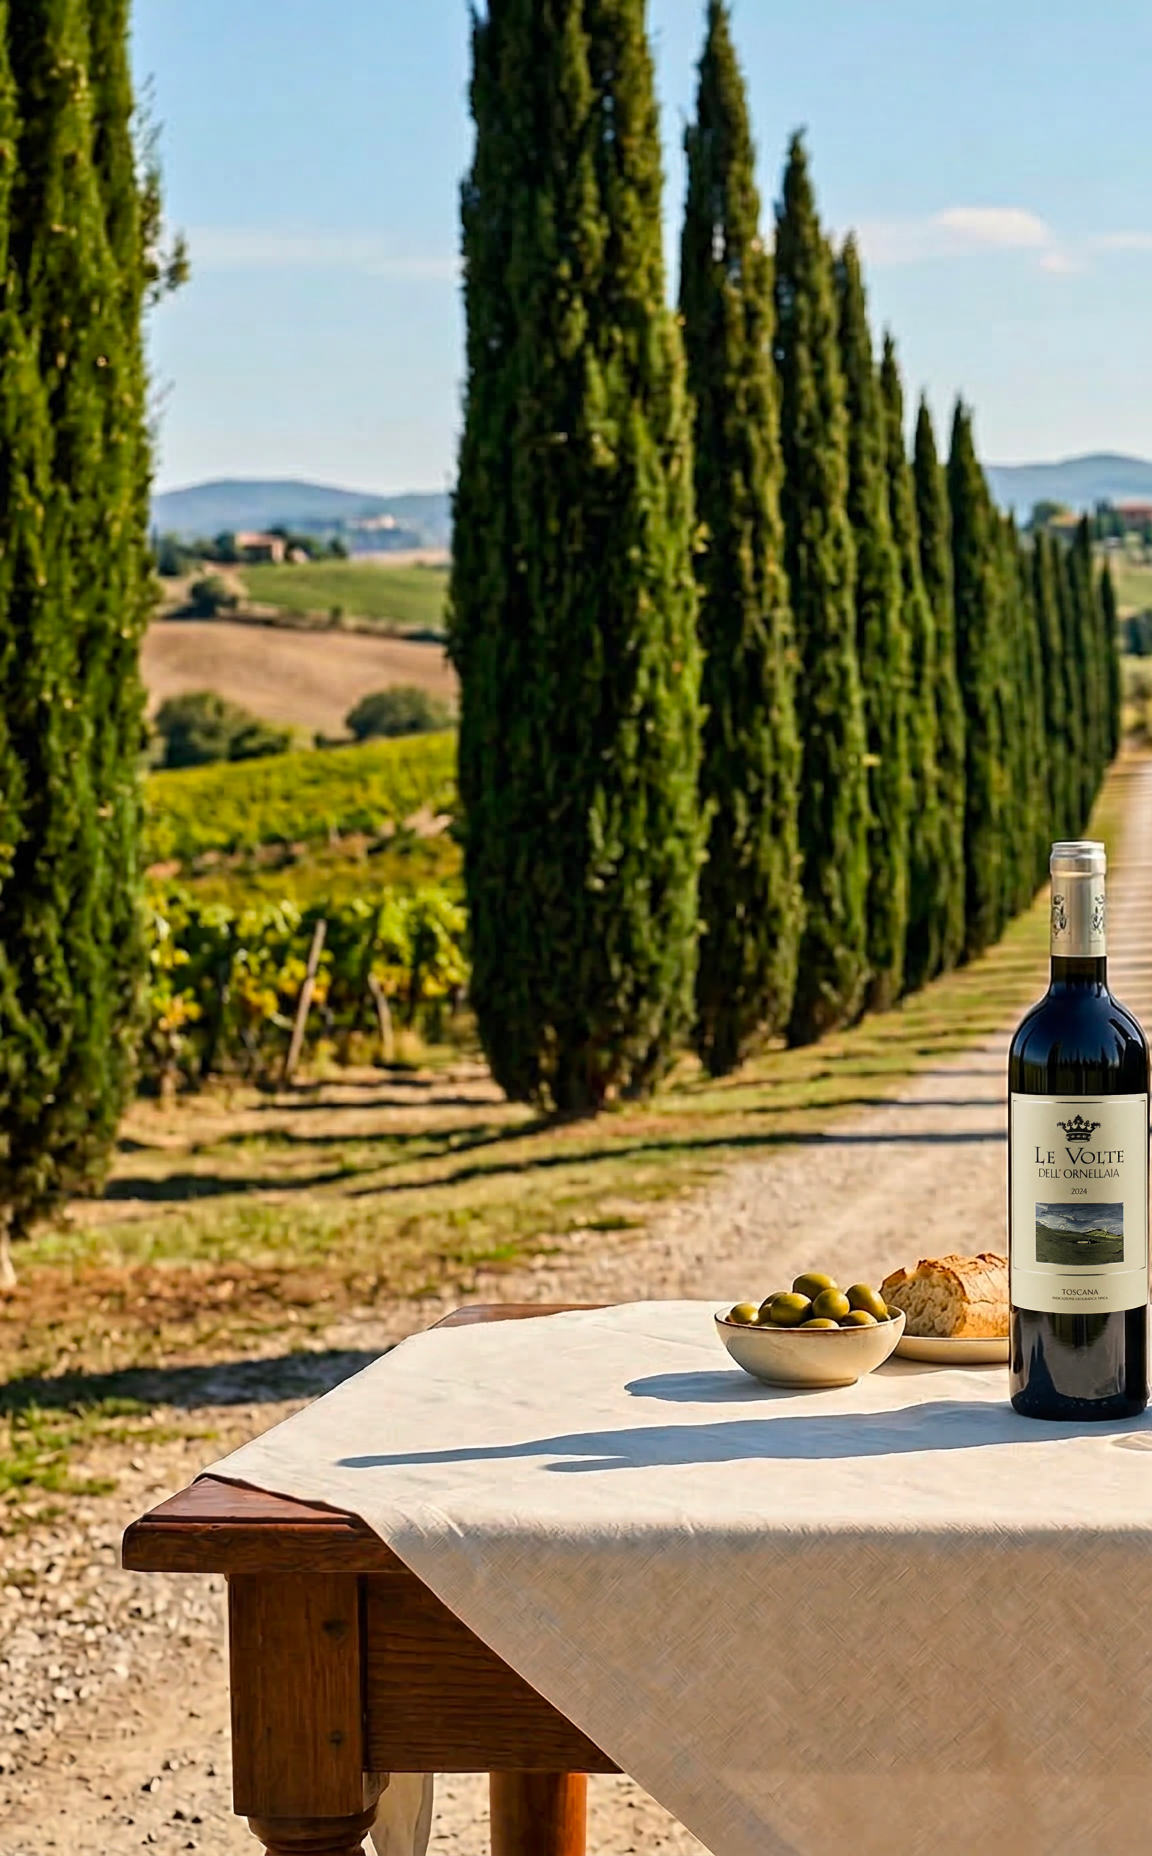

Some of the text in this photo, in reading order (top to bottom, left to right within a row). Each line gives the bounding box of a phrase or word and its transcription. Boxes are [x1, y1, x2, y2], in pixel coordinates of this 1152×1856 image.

[1034, 1146, 1125, 1165] LE VOLTE
[1063, 1168, 1120, 1179] ORNELLAIA
